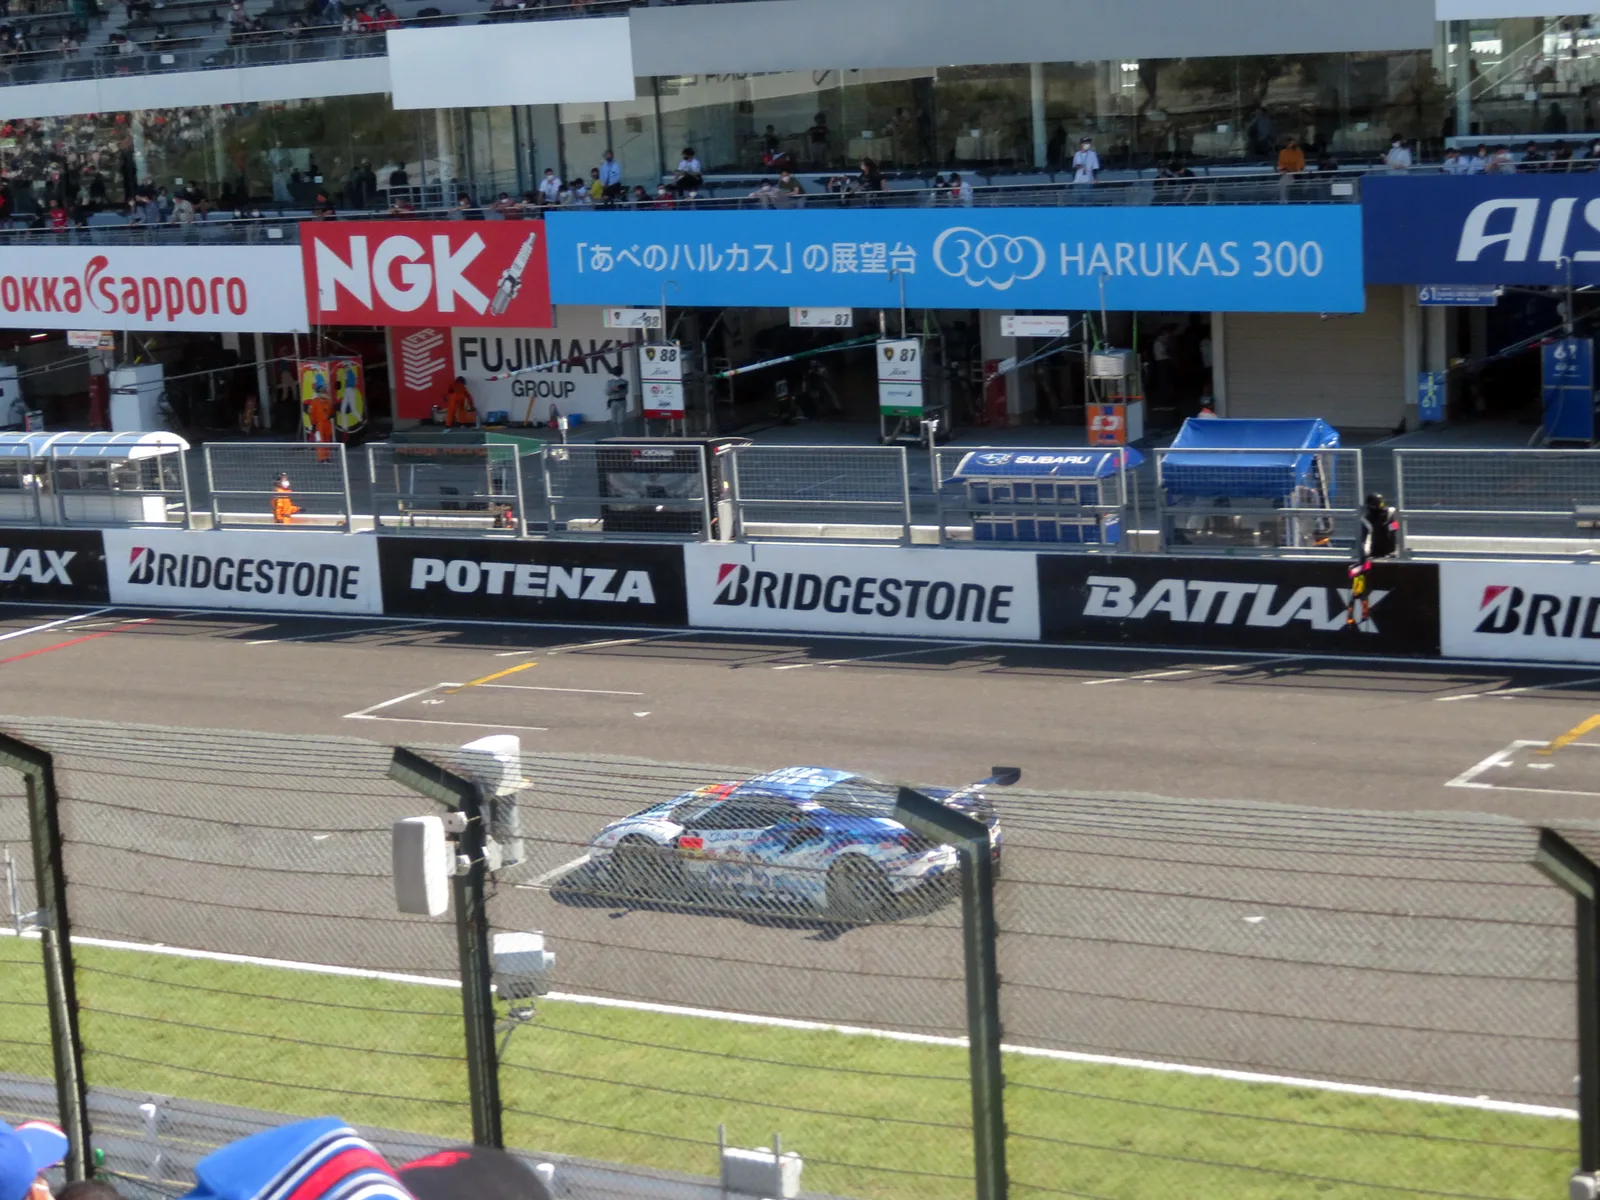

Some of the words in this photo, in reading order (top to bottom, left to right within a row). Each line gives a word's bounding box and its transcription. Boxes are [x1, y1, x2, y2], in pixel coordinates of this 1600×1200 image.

[314, 232, 491, 315] NGK
[576, 241, 917, 275] 「あべのハルカス」の展望台
[1060, 241, 1240, 277] HARUKAS
[1252, 240, 1324, 277] 300
[834, 313, 850, 326] 87
[459, 337, 623, 374] FUJIMAKI
[660, 348, 677, 362] 88
[899, 348, 917, 362] 87
[511, 379, 576, 399] GROUP
[1014, 455, 1092, 464] SUBARU
[128, 546, 360, 600] BRIDGESTONE
[410, 558, 656, 604] POTENZA
[713, 563, 1014, 625] BRIDGESTONE
[1083, 576, 1391, 634] BATTLAX
